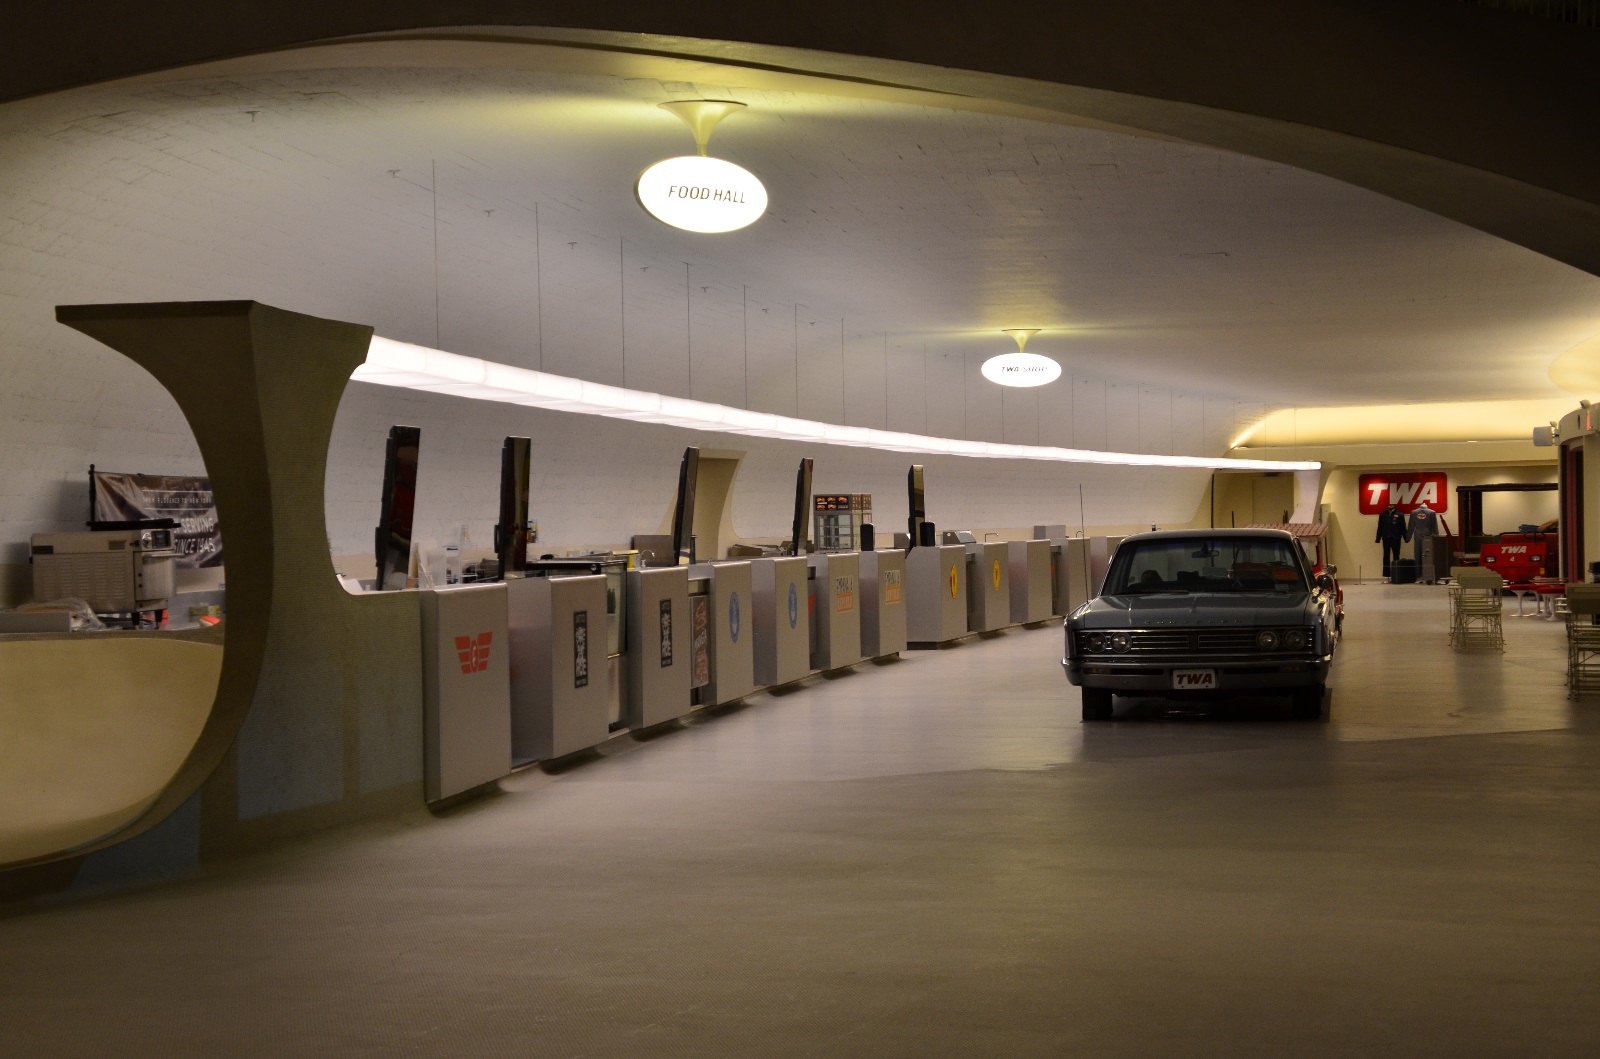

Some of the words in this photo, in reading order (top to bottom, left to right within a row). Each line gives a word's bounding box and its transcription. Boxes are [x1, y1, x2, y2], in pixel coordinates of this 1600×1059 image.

[668, 185, 710, 200] FOOD
[713, 188, 746, 204] HALL
[1367, 481, 1438, 505] TWA
[181, 517, 214, 534] SERVING
[174, 538, 196, 554] SINCE
[196, 537, 216, 553] 1945
[1501, 545, 1527, 554] TWA
[1175, 672, 1213, 685] TWA
